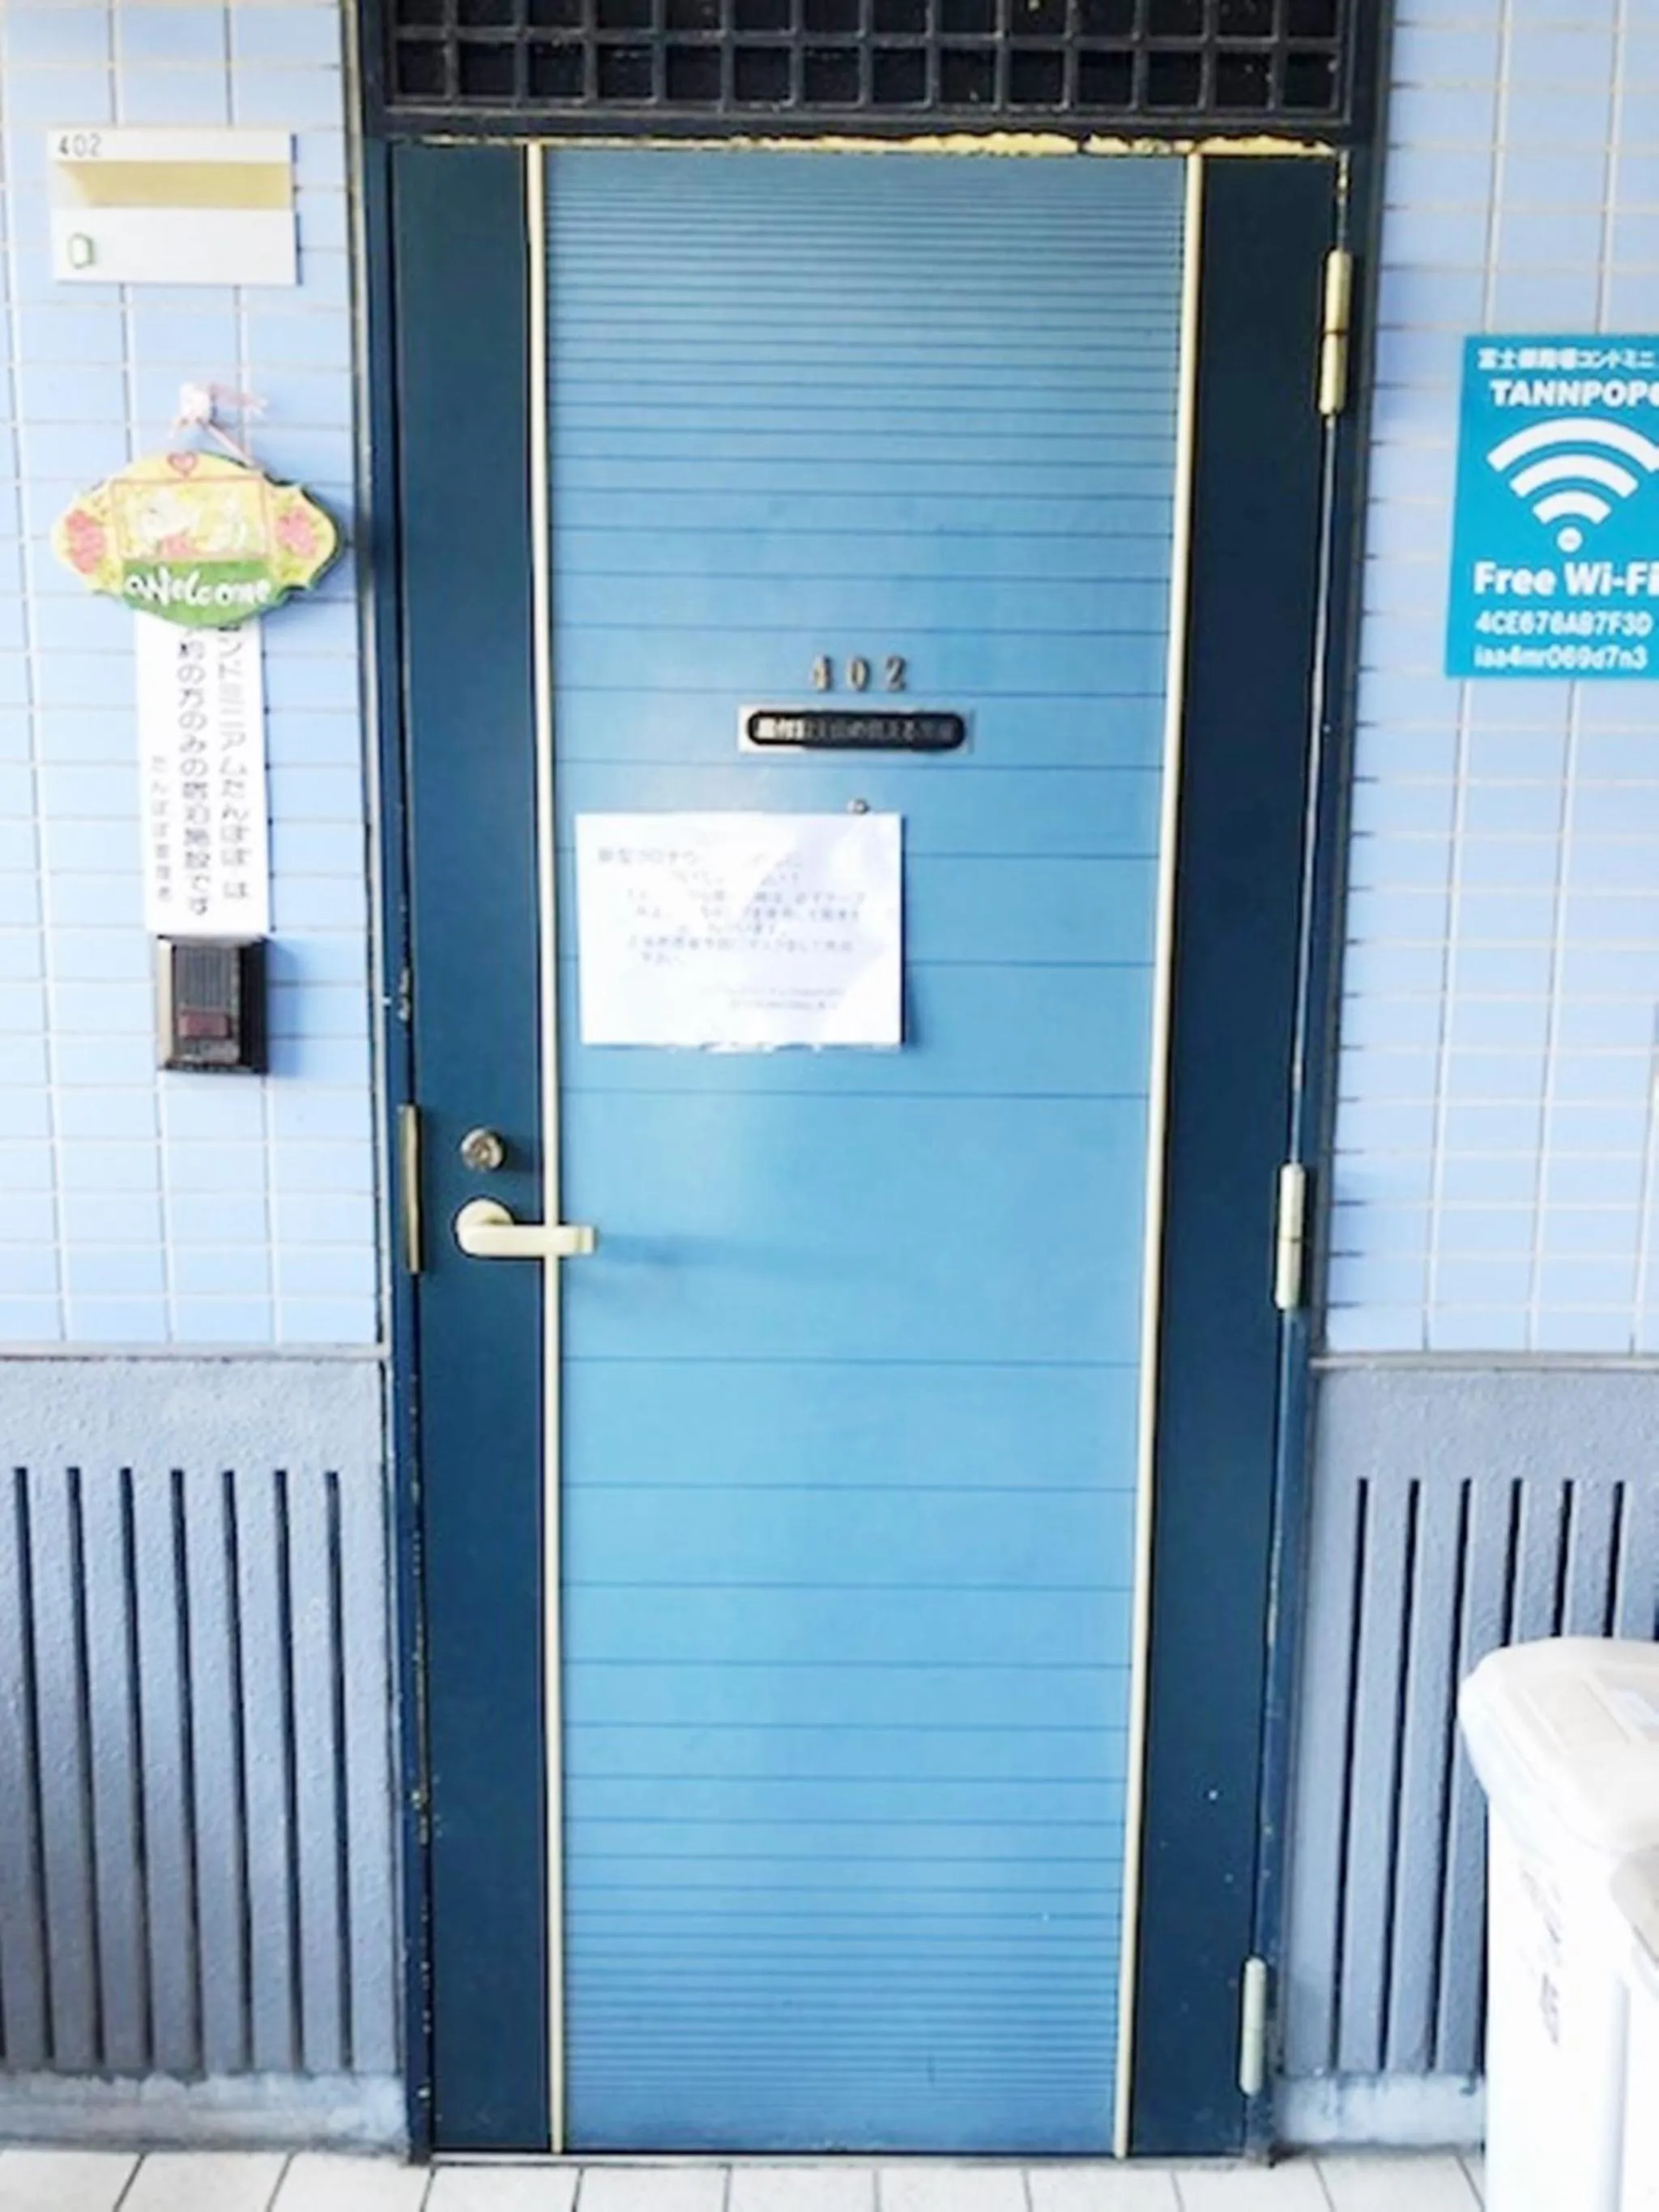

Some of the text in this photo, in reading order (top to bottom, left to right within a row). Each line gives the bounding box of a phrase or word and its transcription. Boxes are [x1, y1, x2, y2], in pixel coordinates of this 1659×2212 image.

[58, 132, 102, 157] 402
[125, 565, 271, 607] Welcome
[1473, 561, 1557, 595] Free
[813, 654, 907, 693] 402
